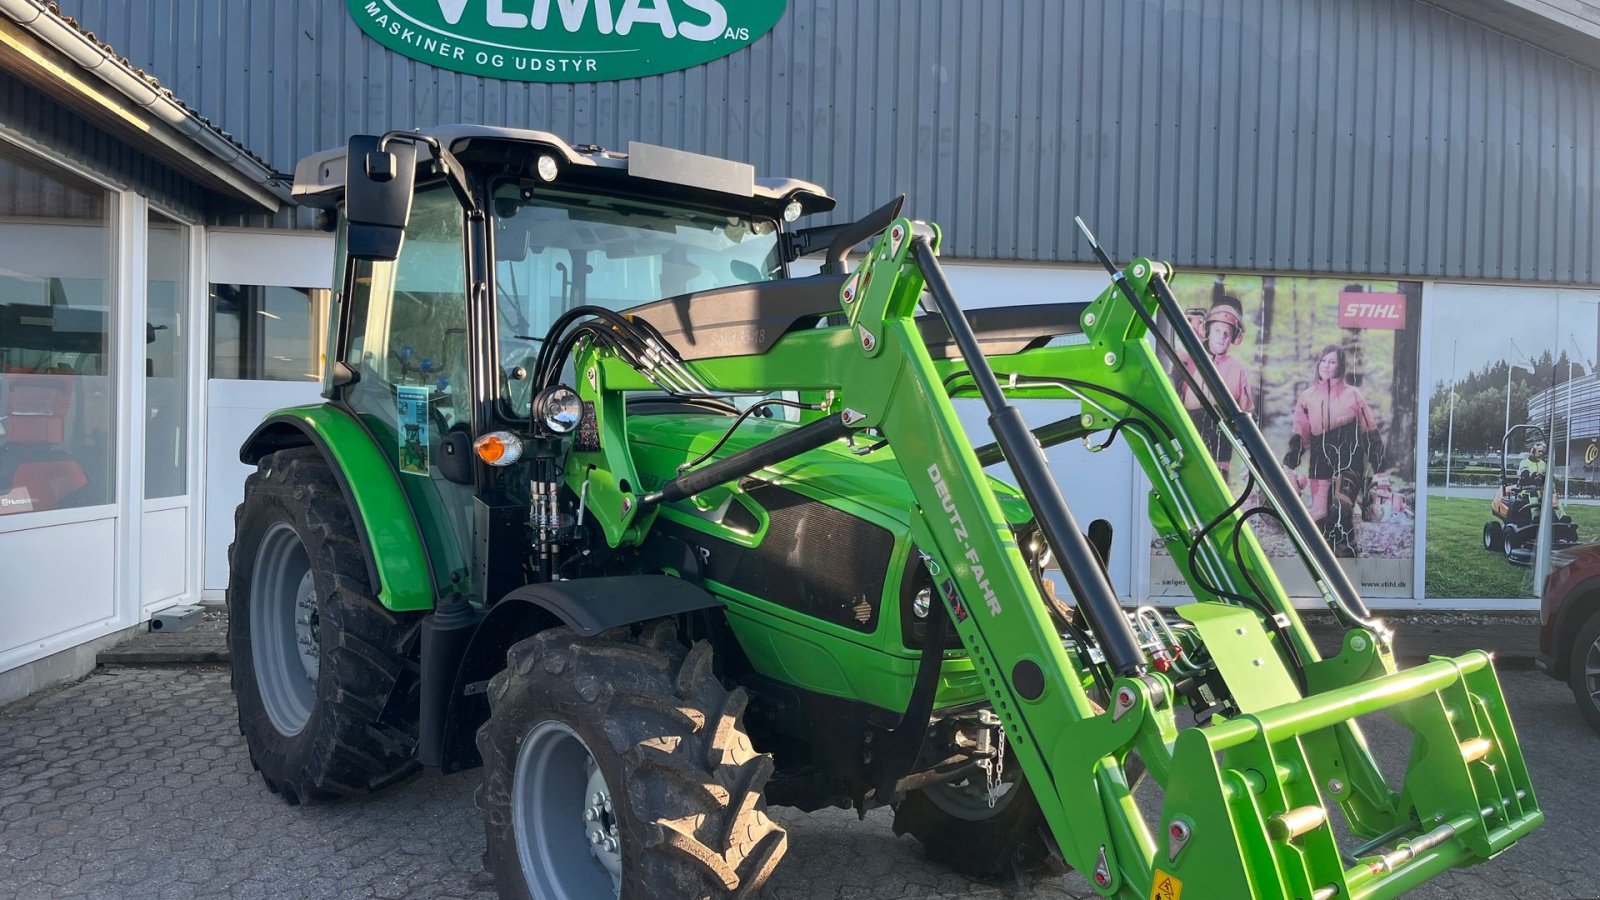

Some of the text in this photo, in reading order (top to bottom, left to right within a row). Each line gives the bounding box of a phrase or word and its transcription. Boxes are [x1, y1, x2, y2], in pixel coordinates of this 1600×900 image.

[364, 1, 597, 72] MASKINER OG UDSTYR
[724, 27, 750, 41] A/S
[1344, 303, 1400, 319] STIHL
[927, 463, 1002, 618] DEUTZ-FAHR
[1161, 579, 1187, 587] sælges
